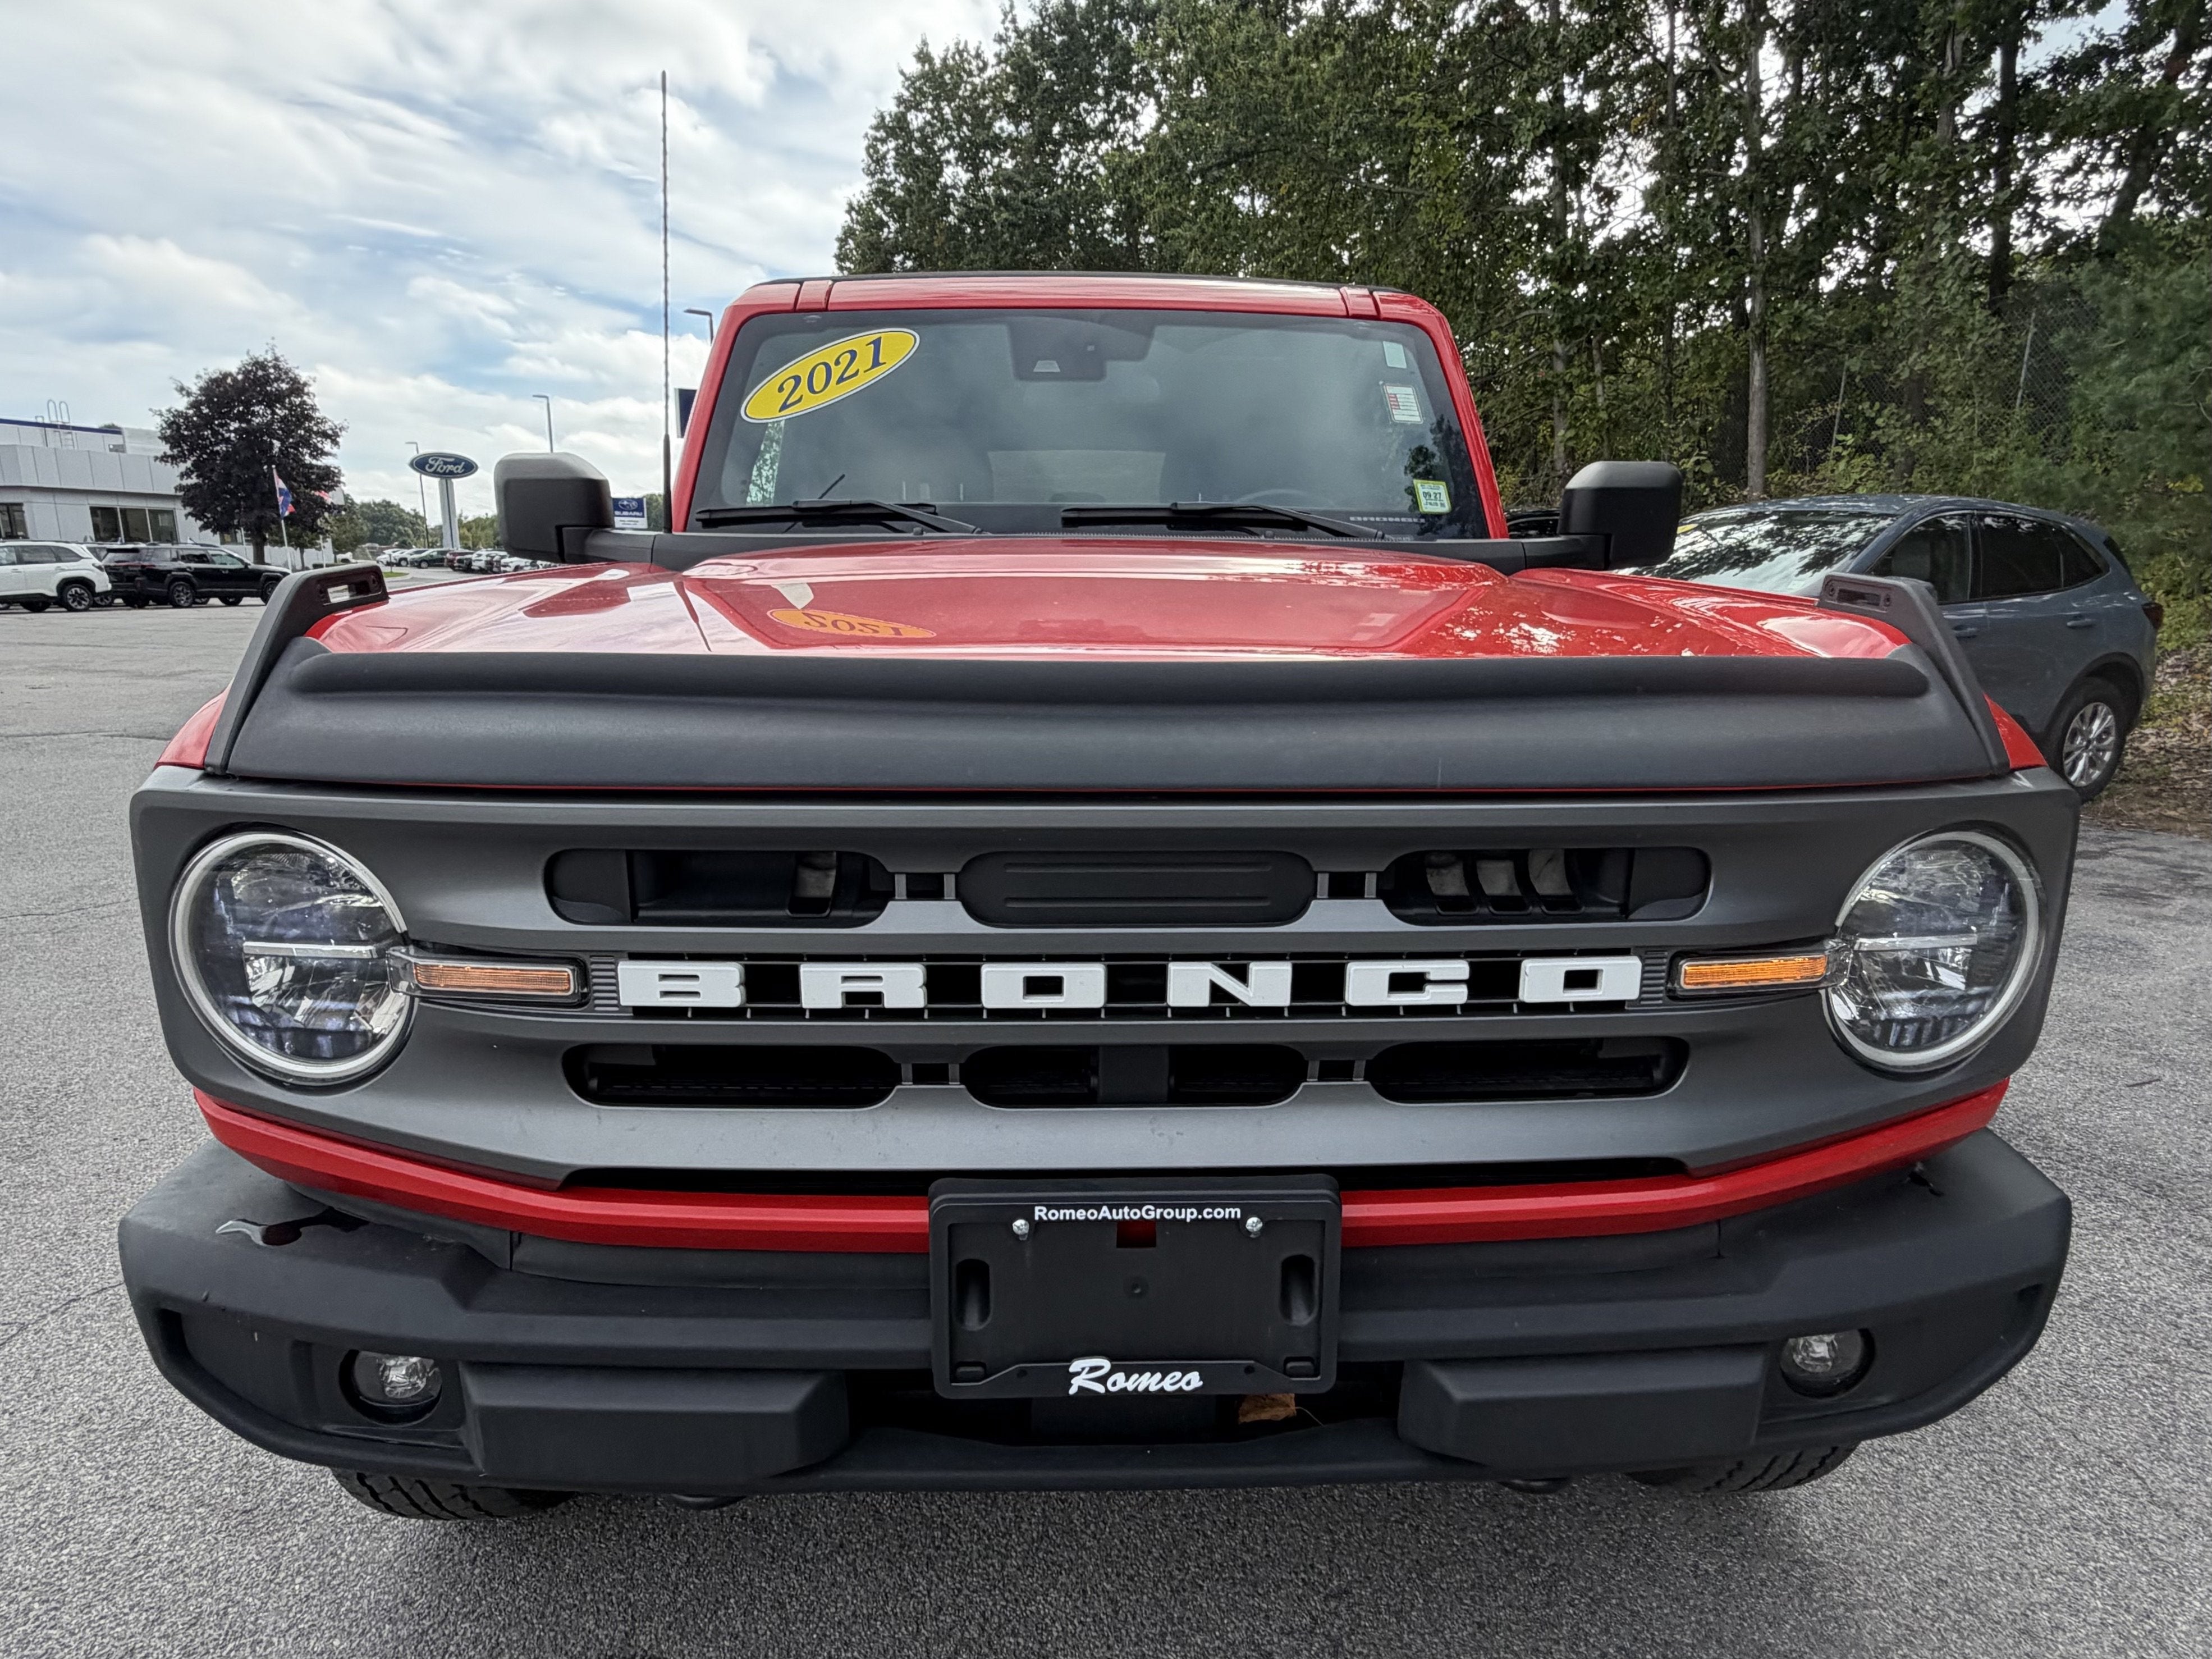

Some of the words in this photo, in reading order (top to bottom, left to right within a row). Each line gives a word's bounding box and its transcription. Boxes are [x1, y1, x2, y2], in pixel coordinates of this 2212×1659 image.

[777, 336, 886, 413] 2021
[425, 456, 465, 473] Ford
[1433, 492, 1441, 500] 27
[617, 956, 1642, 1008] BRONCO
[1034, 1205, 1241, 1222] RomeoAutoGroup.com
[1068, 1358, 1203, 1395] Romeo
